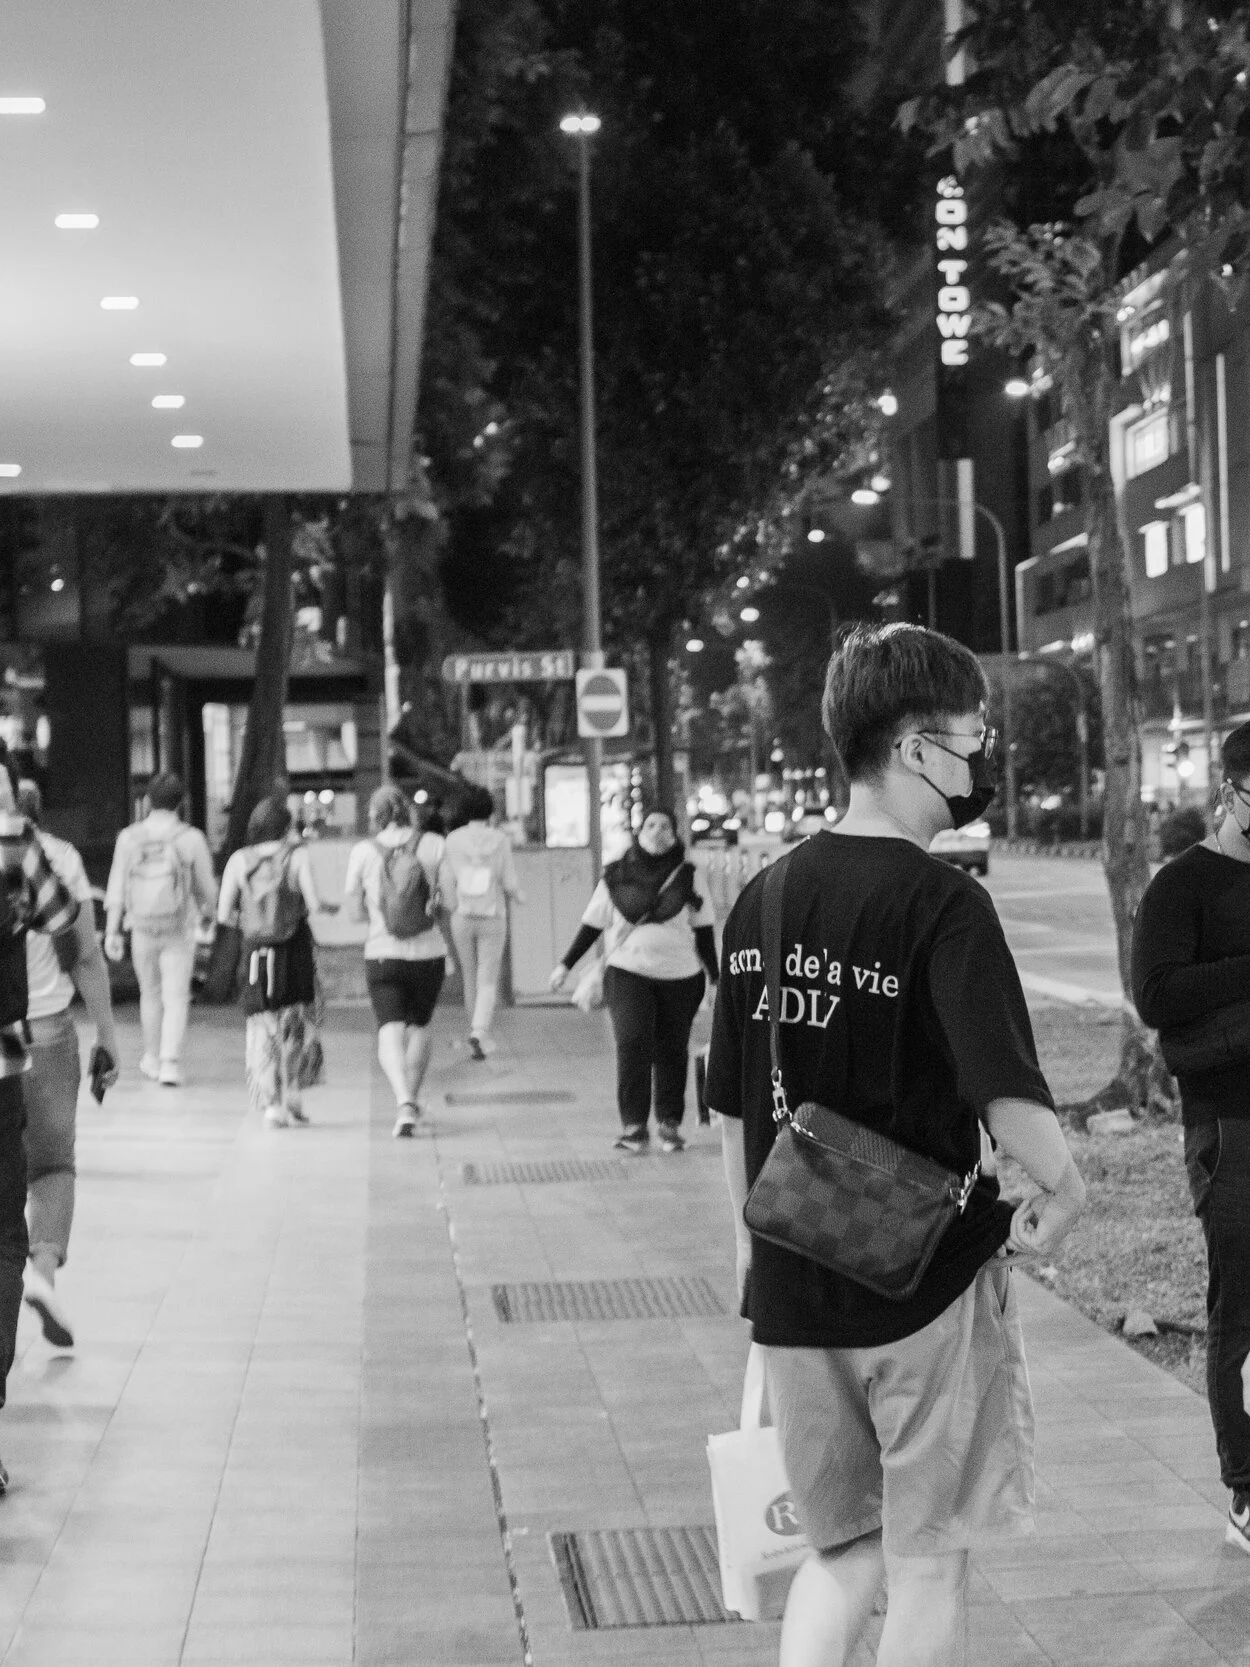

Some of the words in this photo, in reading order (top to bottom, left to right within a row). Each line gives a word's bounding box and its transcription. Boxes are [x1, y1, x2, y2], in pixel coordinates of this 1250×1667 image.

[455, 657, 532, 681] Purvis
[540, 655, 566, 679] St
[729, 948, 765, 976] acm
[785, 943, 820, 979] de
[852, 961, 899, 997] vie
